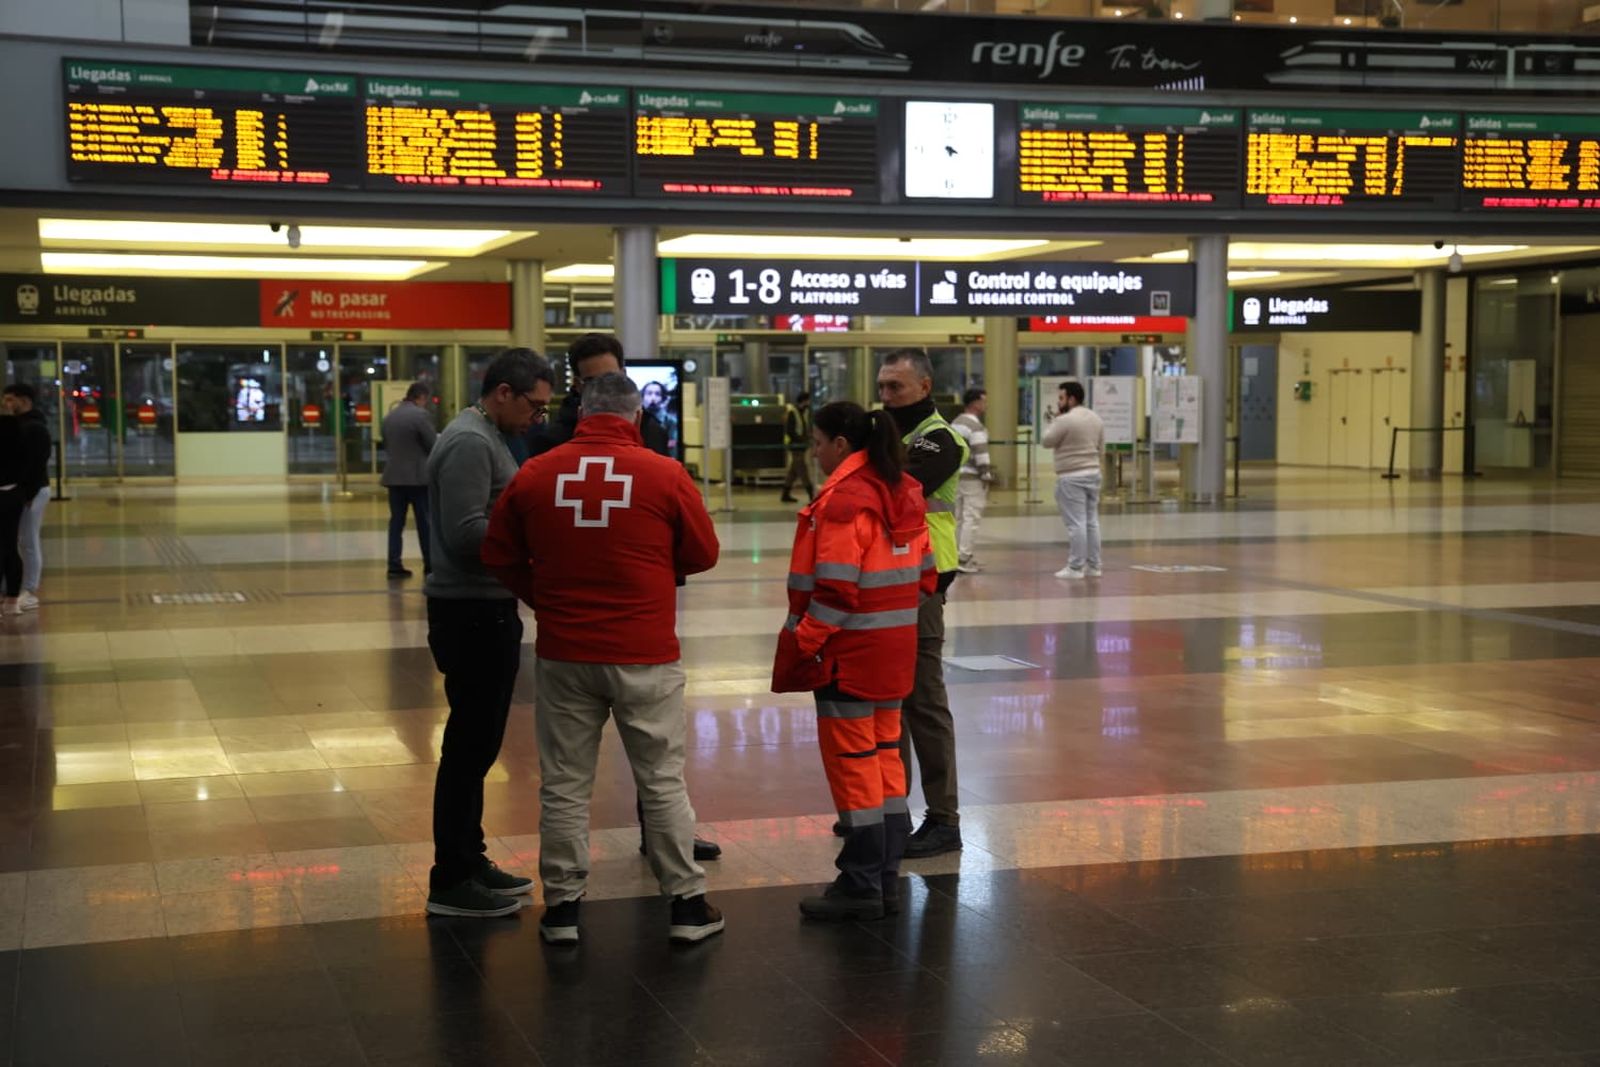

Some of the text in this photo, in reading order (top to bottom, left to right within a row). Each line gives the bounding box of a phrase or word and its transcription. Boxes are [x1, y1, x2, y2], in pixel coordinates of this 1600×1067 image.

[971, 31, 1085, 79] renfe
[1140, 48, 1200, 70] tren
[71, 66, 131, 83] Llegadas
[368, 82, 423, 97] Llegadas
[639, 94, 689, 109] Llegadas
[1024, 107, 1060, 121] Salidas
[1251, 113, 1286, 125] Salidas
[1469, 117, 1502, 129] Salidas
[728, 268, 782, 304] 1-8
[790, 268, 907, 289] Acceso a vías
[968, 271, 1143, 294] Control de equipajes
[53, 285, 136, 305] Llegadas
[310, 290, 388, 309] No pasar
[790, 291, 860, 305] PLATFORMS
[968, 293, 1076, 306] LUGGAGE CONTROL
[54, 306, 107, 316] ARRIVALS
[1268, 297, 1329, 316] Llegadas
[310, 310, 391, 320] NO TRESPASSING
